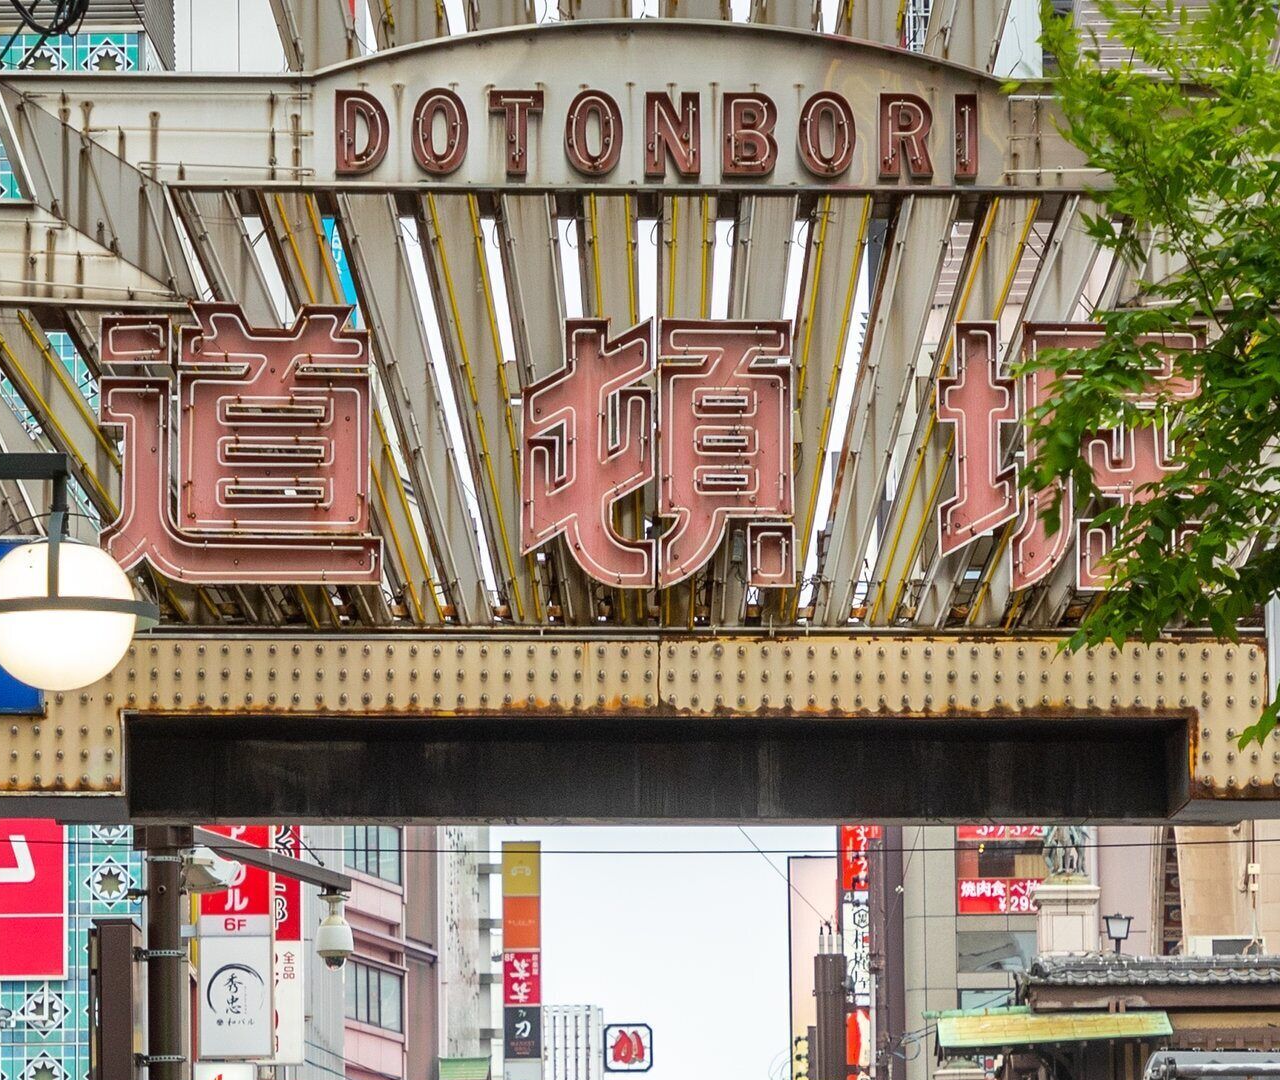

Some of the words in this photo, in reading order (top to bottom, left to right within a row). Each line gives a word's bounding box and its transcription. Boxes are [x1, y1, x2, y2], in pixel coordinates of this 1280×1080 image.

[335, 88, 979, 178] DOTONBORI
[100, 302, 1207, 592] 道頓堀
[223, 917, 247, 931] 6F
[283, 951, 296, 980] 全品
